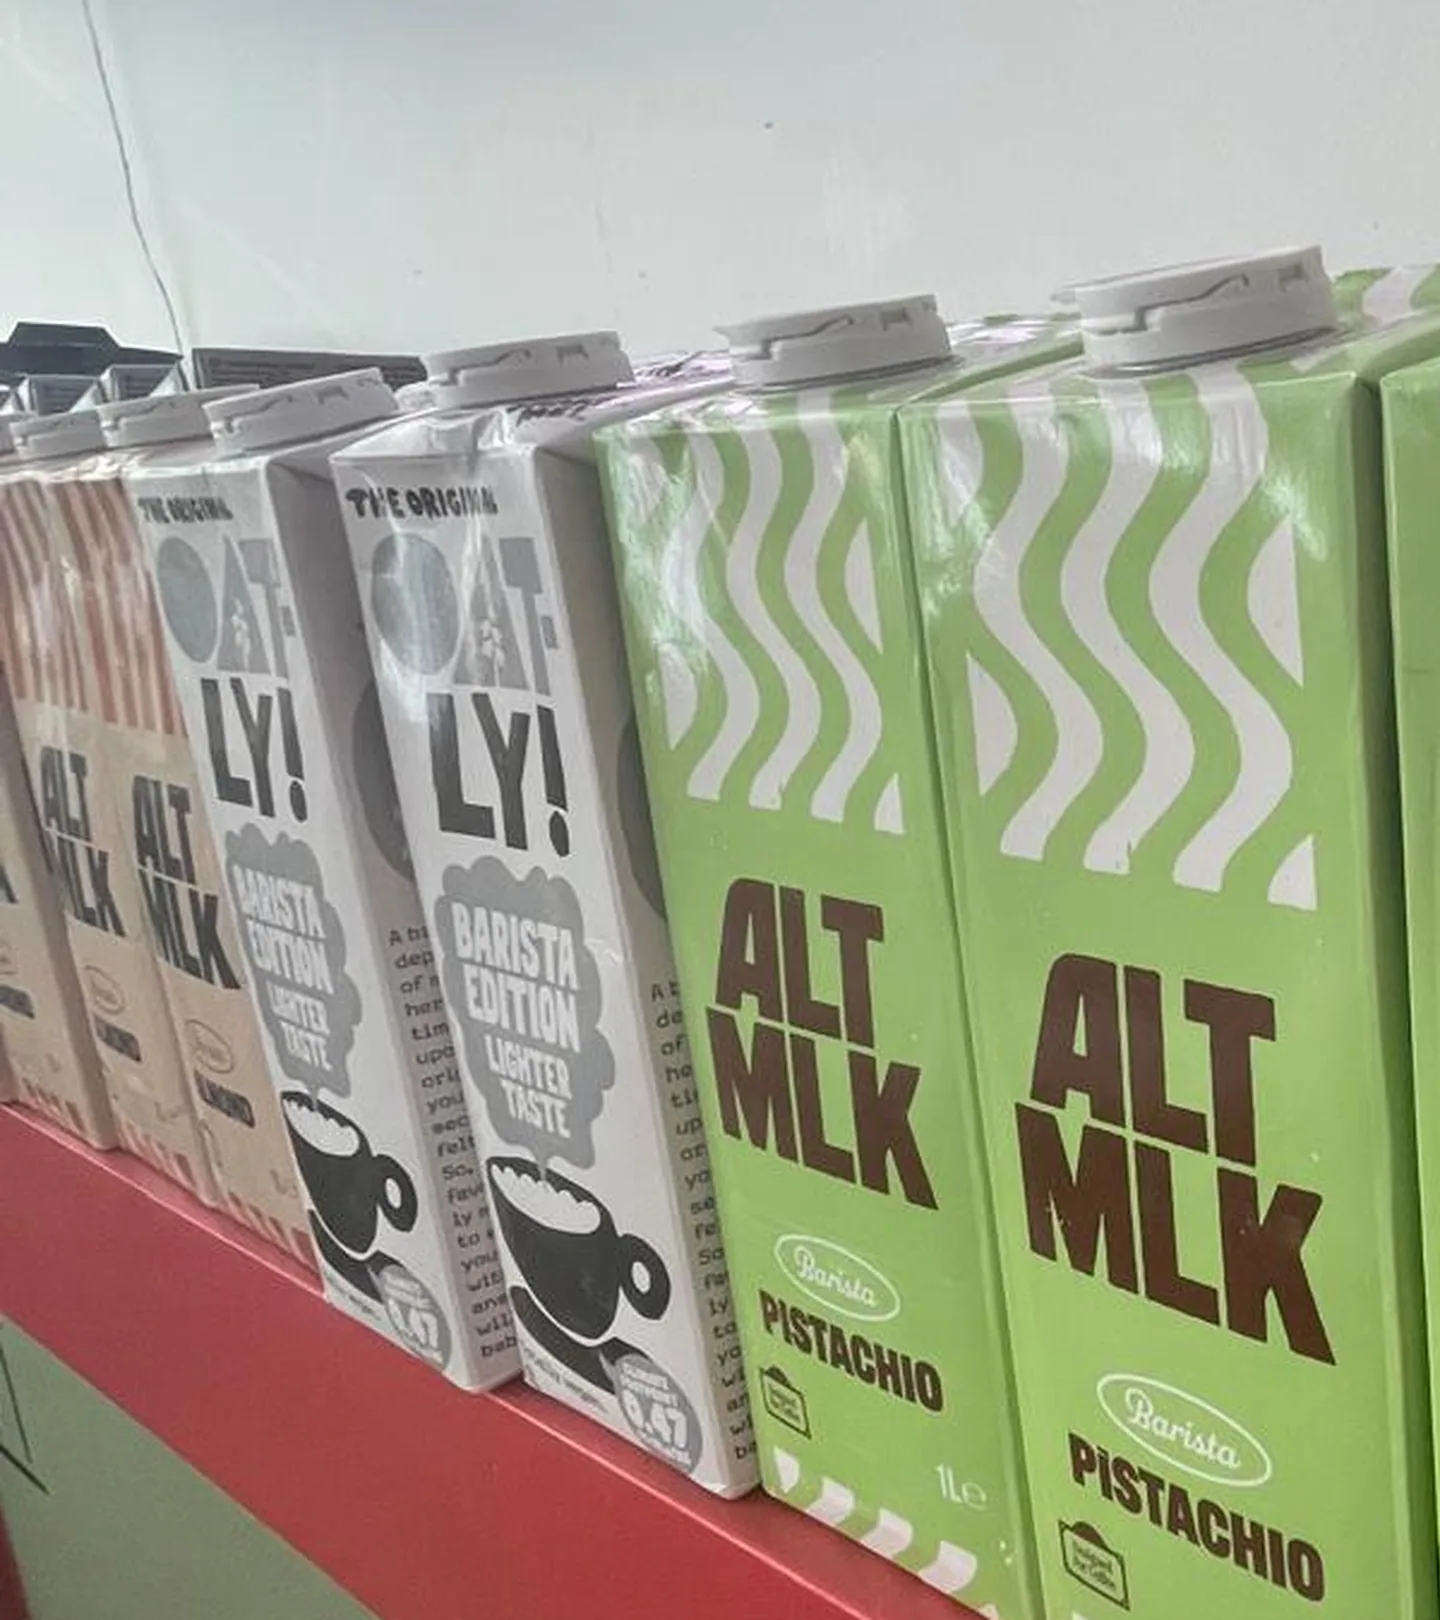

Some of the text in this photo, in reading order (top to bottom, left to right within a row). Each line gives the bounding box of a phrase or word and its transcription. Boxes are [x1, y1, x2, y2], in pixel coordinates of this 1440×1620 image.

[345, 486, 405, 518] THE
[40, 745, 92, 843] ALT
[201, 676, 308, 823] LY!
[426, 691, 570, 857] LY!
[132, 774, 196, 886] ALT
[137, 865, 241, 989] MLK
[451, 901, 580, 992] BARISTA
[715, 877, 885, 1050] ALT
[462, 963, 581, 1054] EDITION
[1030, 952, 1277, 1169] ALT
[484, 1033, 573, 1101] LIGHTER
[500, 1078, 571, 1139] TASTE
[706, 1006, 939, 1211] MLK
[793, 1244, 877, 1308] Barista
[1014, 1102, 1337, 1366] MLK
[1124, 1386, 1242, 1469] Barista
